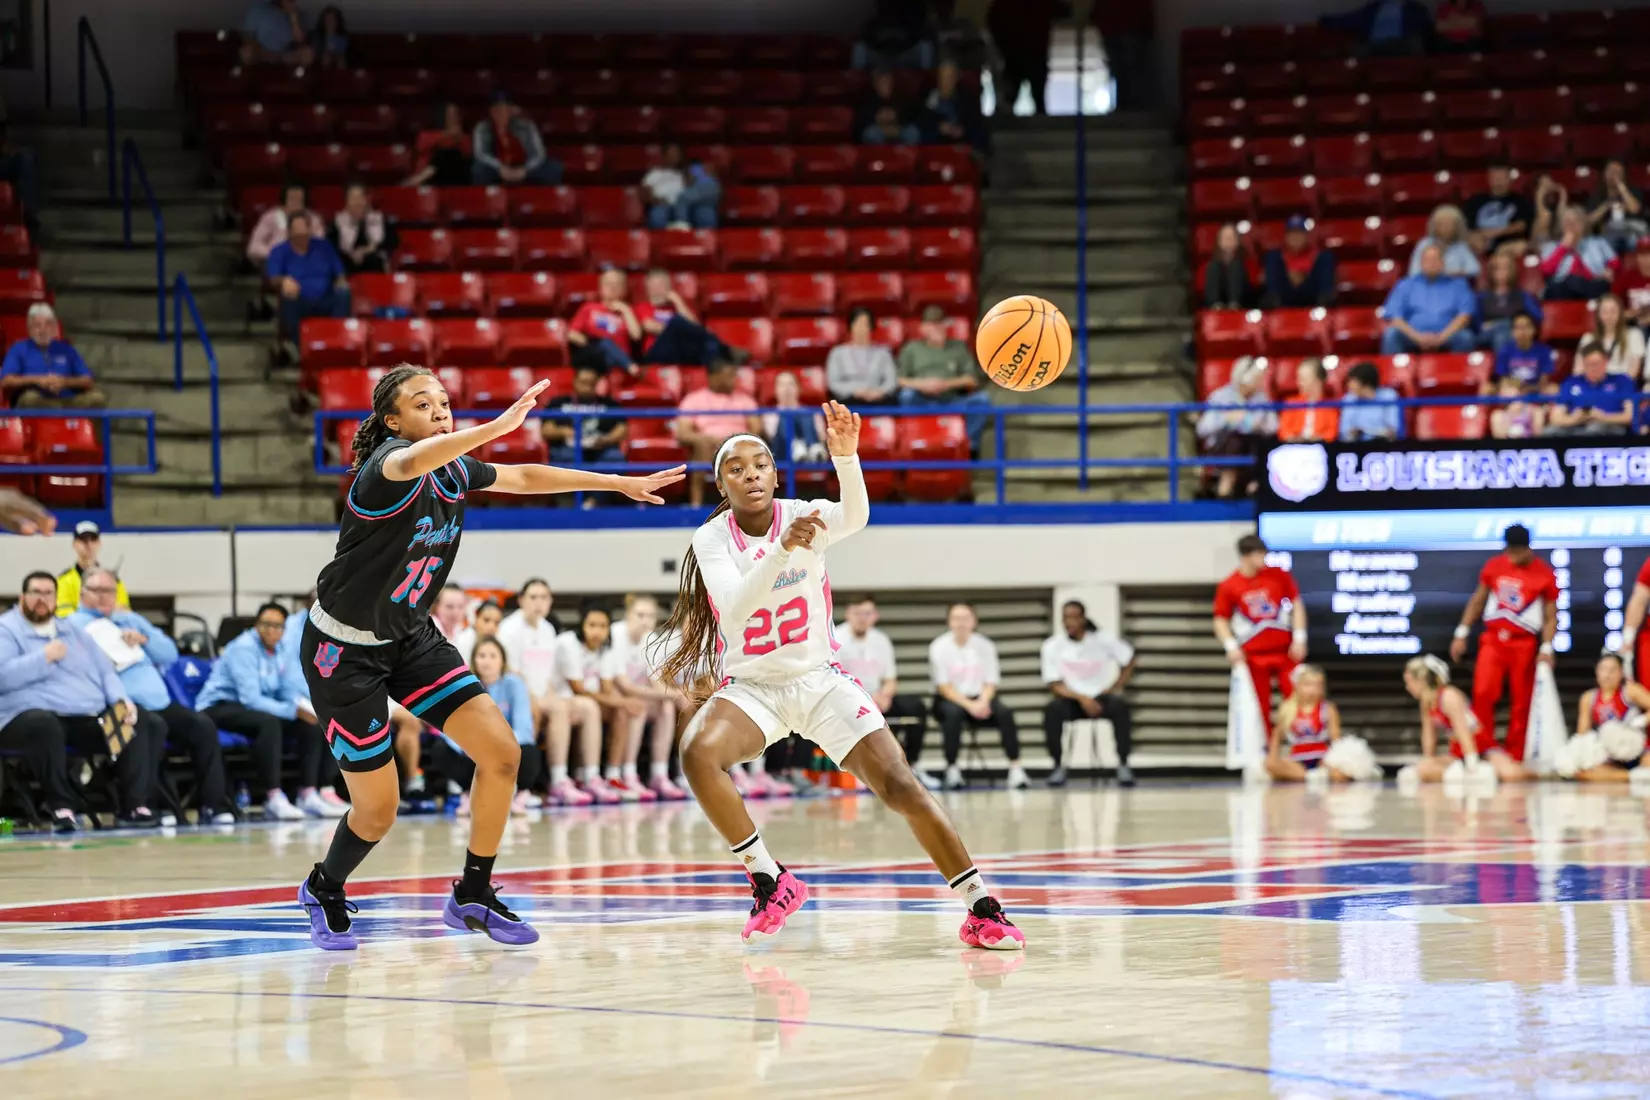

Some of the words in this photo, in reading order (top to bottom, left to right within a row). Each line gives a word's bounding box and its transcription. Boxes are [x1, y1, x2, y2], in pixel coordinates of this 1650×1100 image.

[1336, 449, 1565, 492] LOUISIANA
[390, 556, 444, 608] 15
[742, 596, 811, 656] 22
